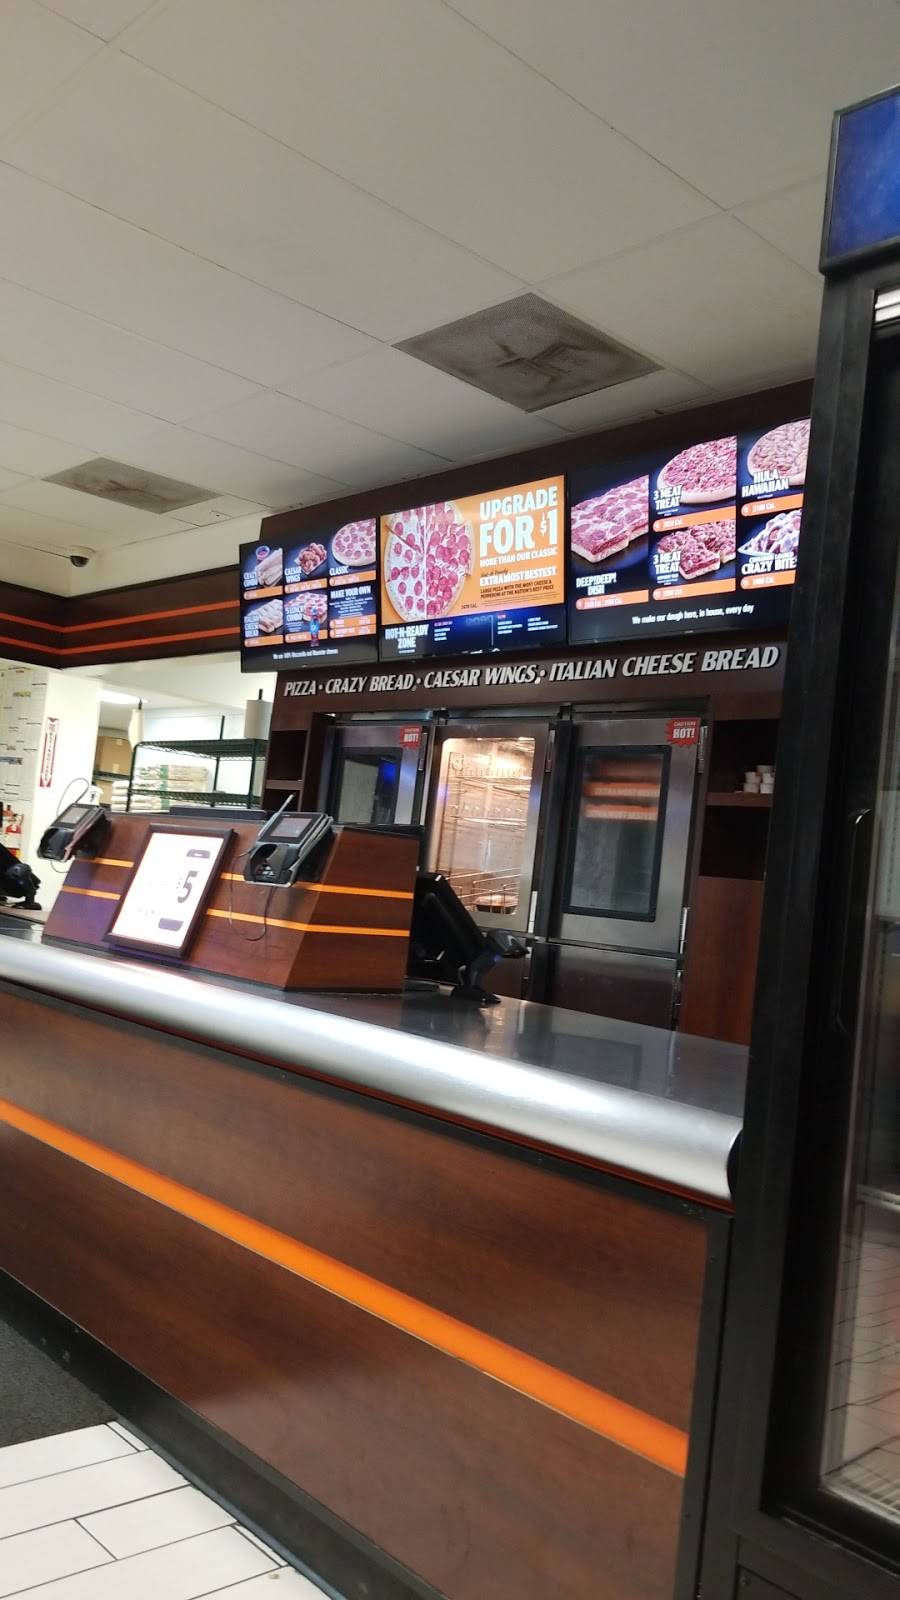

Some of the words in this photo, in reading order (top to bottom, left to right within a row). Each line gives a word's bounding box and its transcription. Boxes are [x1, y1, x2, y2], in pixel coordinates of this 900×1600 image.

[754, 470, 780, 483] HULA
[654, 490, 660, 500] 3
[660, 485, 682, 499] MEAT
[742, 479, 789, 498] HAWAIIAN
[480, 486, 558, 520] UPGRADE
[655, 496, 680, 510] TREAT
[480, 514, 535, 558] FOR
[498, 554, 516, 564] THAN
[516, 552, 531, 561] OUR
[531, 547, 558, 558] CLASSIC
[653, 555, 660, 565] 3
[660, 550, 681, 564] MEAT
[655, 562, 680, 575] TREAT
[742, 559, 772, 575] CRAZY
[576, 572, 617, 588] DEEP!DEEP!
[345, 588, 358, 597] YOUR
[359, 586, 371, 594] OWN
[588, 584, 604, 596] DISH
[632, 616, 640, 624] We
[642, 614, 655, 623] make
[657, 614, 666, 622] our
[667, 611, 683, 622] dough
[726, 606, 741, 616] every
[743, 604, 754, 613] day
[384, 624, 430, 640] HOT-N-READY
[398, 636, 416, 649] ZONE
[284, 680, 316, 697] PIZZA
[325, 676, 368, 694] CRAZY
[424, 668, 480, 688] CAESAR
[549, 659, 618, 682] ITALIAN
[622, 652, 698, 677] CHEESE
[700, 646, 780, 672] BREAD
[404, 733, 419, 742] HOT!
[672, 728, 696, 739] HOT!
